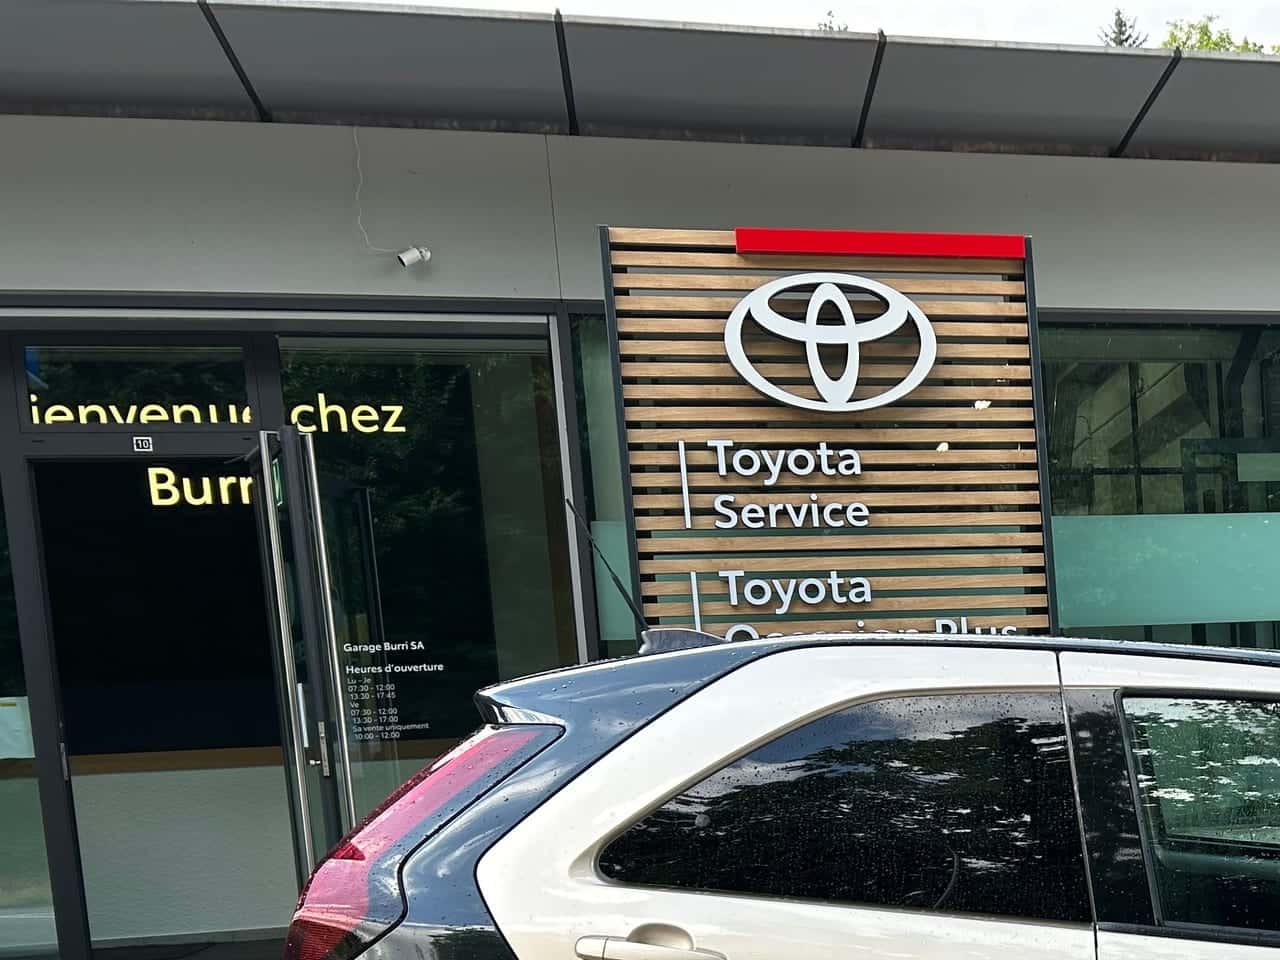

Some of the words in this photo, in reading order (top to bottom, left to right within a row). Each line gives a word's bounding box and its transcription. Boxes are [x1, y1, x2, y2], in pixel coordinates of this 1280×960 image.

[291, 393, 406, 432] chez
[137, 440, 149, 449] 10
[707, 440, 861, 486] Toyota
[148, 467, 253, 506] Burr
[714, 493, 870, 528] Service
[718, 570, 872, 614] Toyota
[343, 643, 382, 653] Garage
[383, 641, 409, 651] Burri
[410, 641, 425, 650] SA
[345, 665, 383, 674] Heures
[384, 663, 444, 673] d'ouverture
